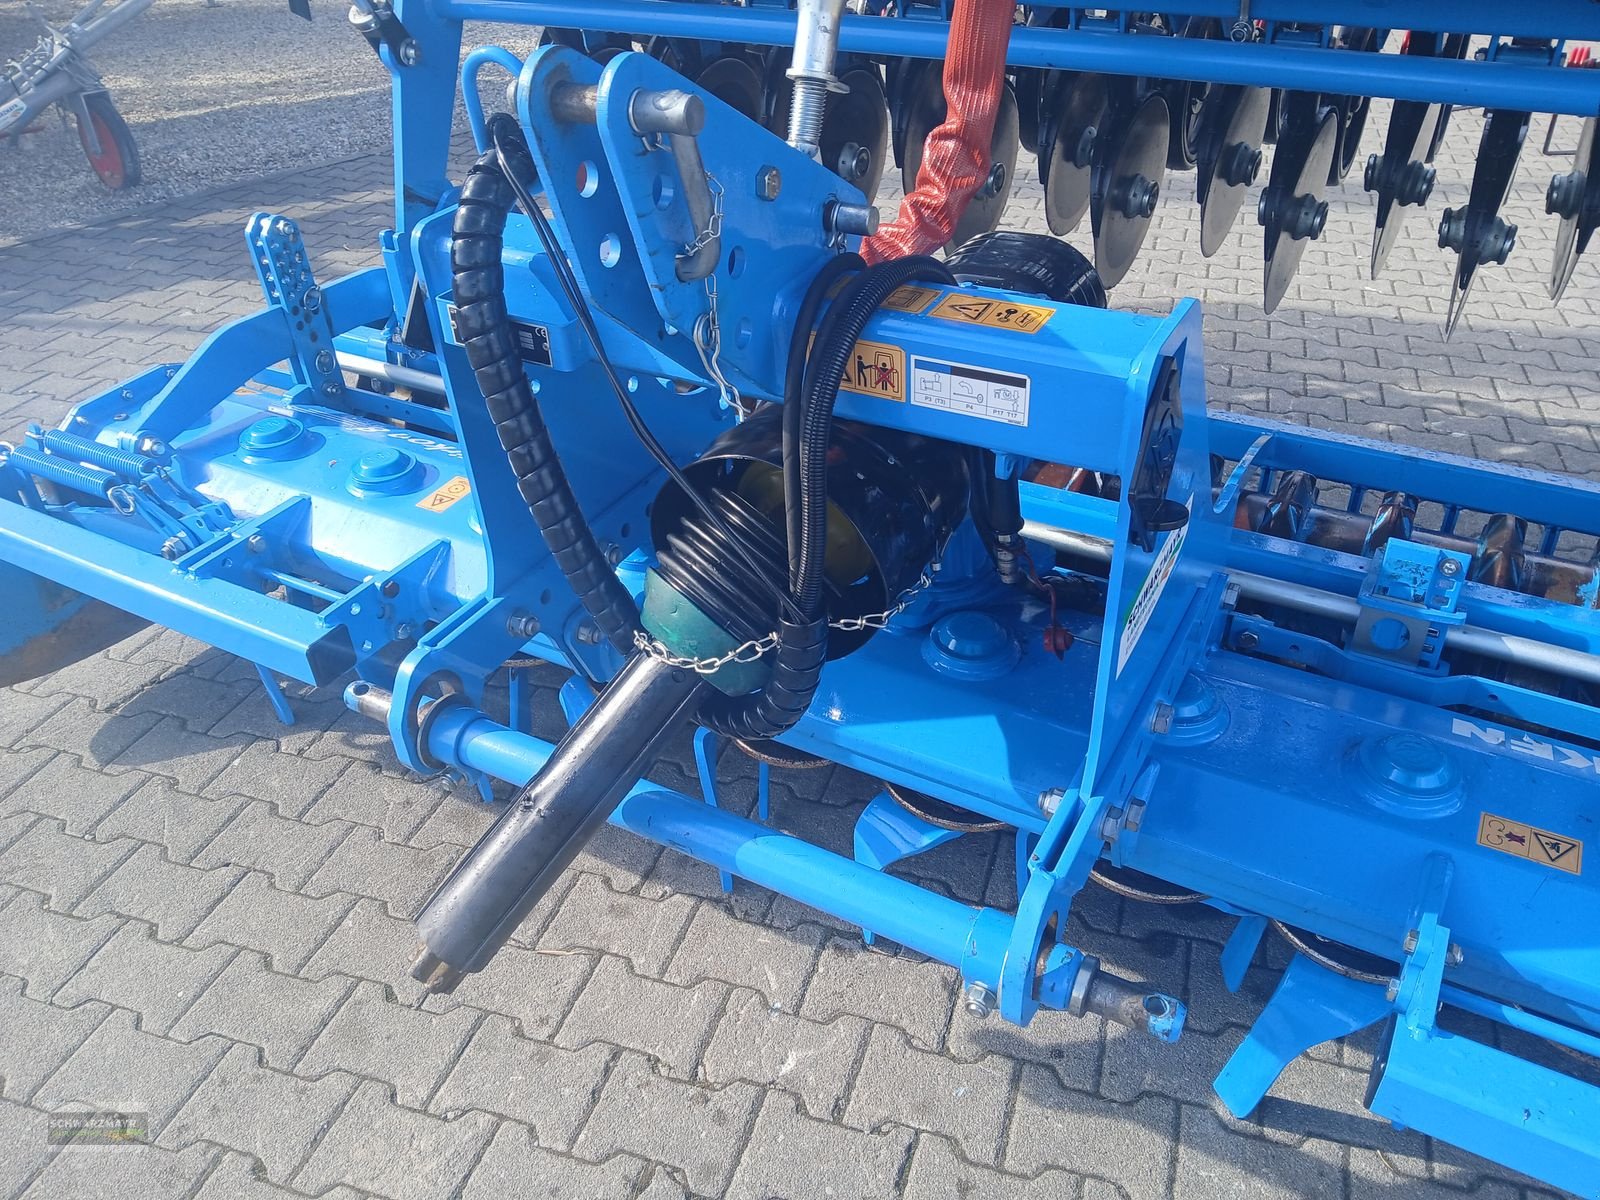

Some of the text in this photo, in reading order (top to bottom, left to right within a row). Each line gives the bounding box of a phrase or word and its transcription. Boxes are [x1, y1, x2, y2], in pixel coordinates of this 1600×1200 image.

[924, 395, 947, 406] P3 (T3)
[965, 403, 974, 411] P4
[992, 409, 1004, 417] P17
[387, 432, 464, 459] irkon
